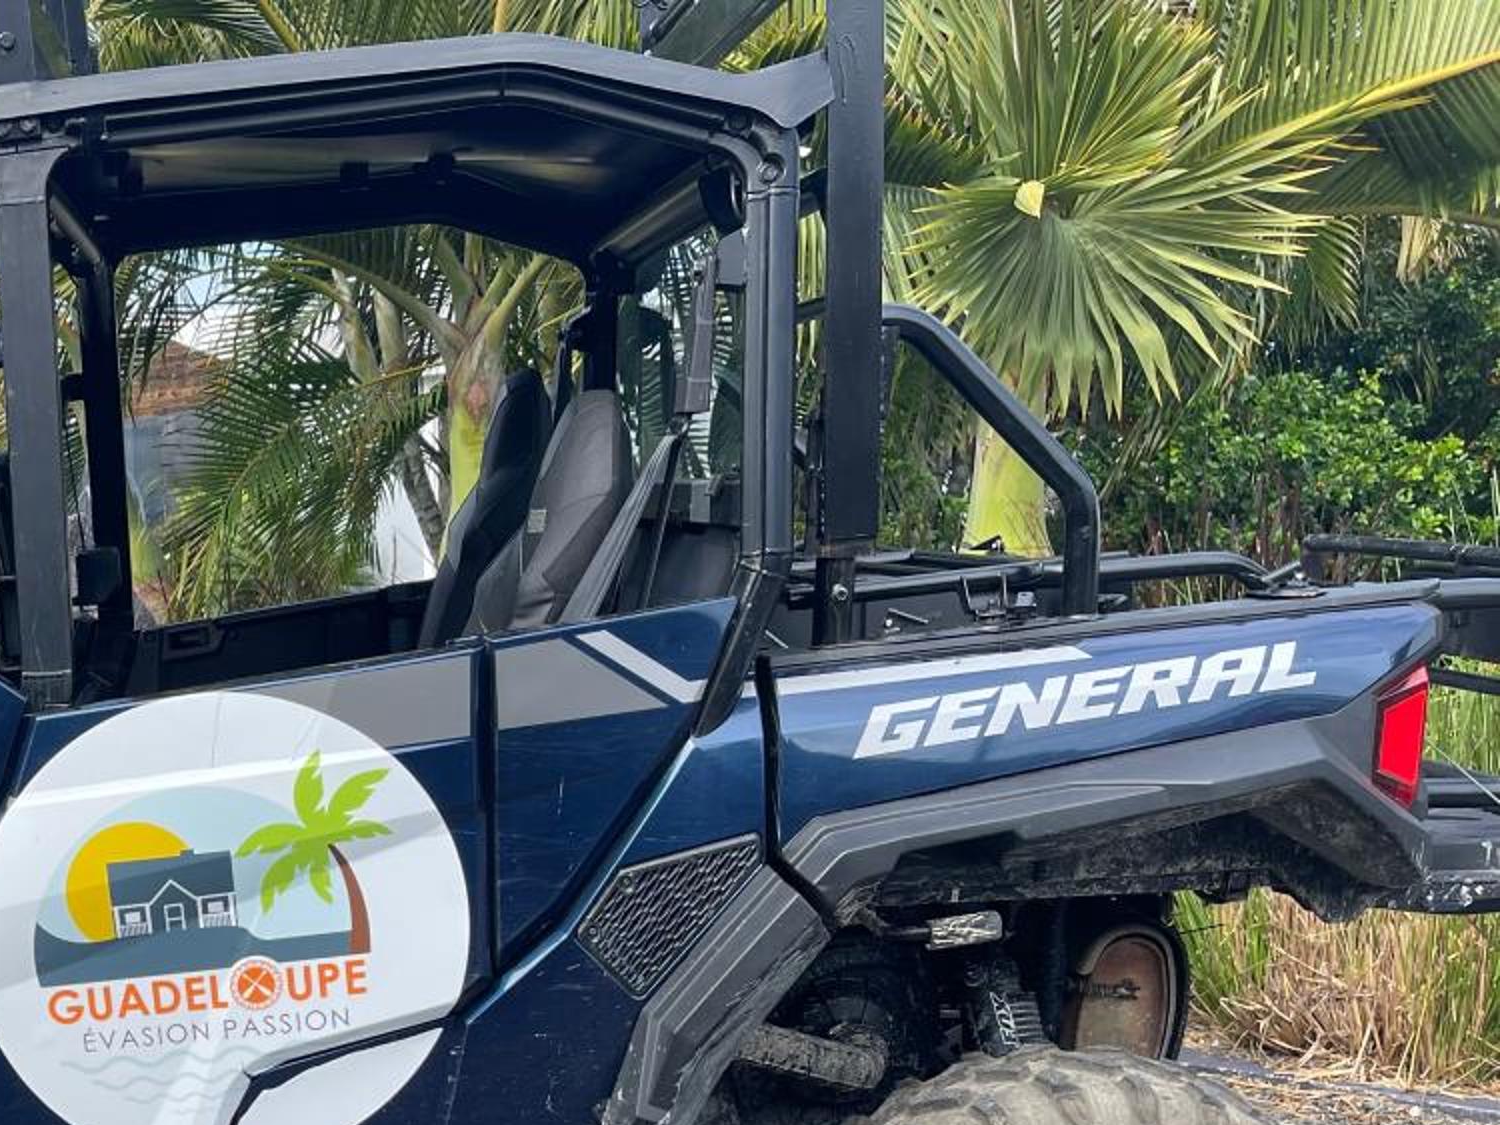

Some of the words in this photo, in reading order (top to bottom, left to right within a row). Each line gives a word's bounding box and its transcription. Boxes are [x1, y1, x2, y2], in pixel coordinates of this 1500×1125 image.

[852, 640, 1317, 760] GENERAL
[47, 956, 369, 1026] GUADELOUPE
[82, 1023, 211, 1054] ÉVASION
[222, 1008, 351, 1041] PASSION
